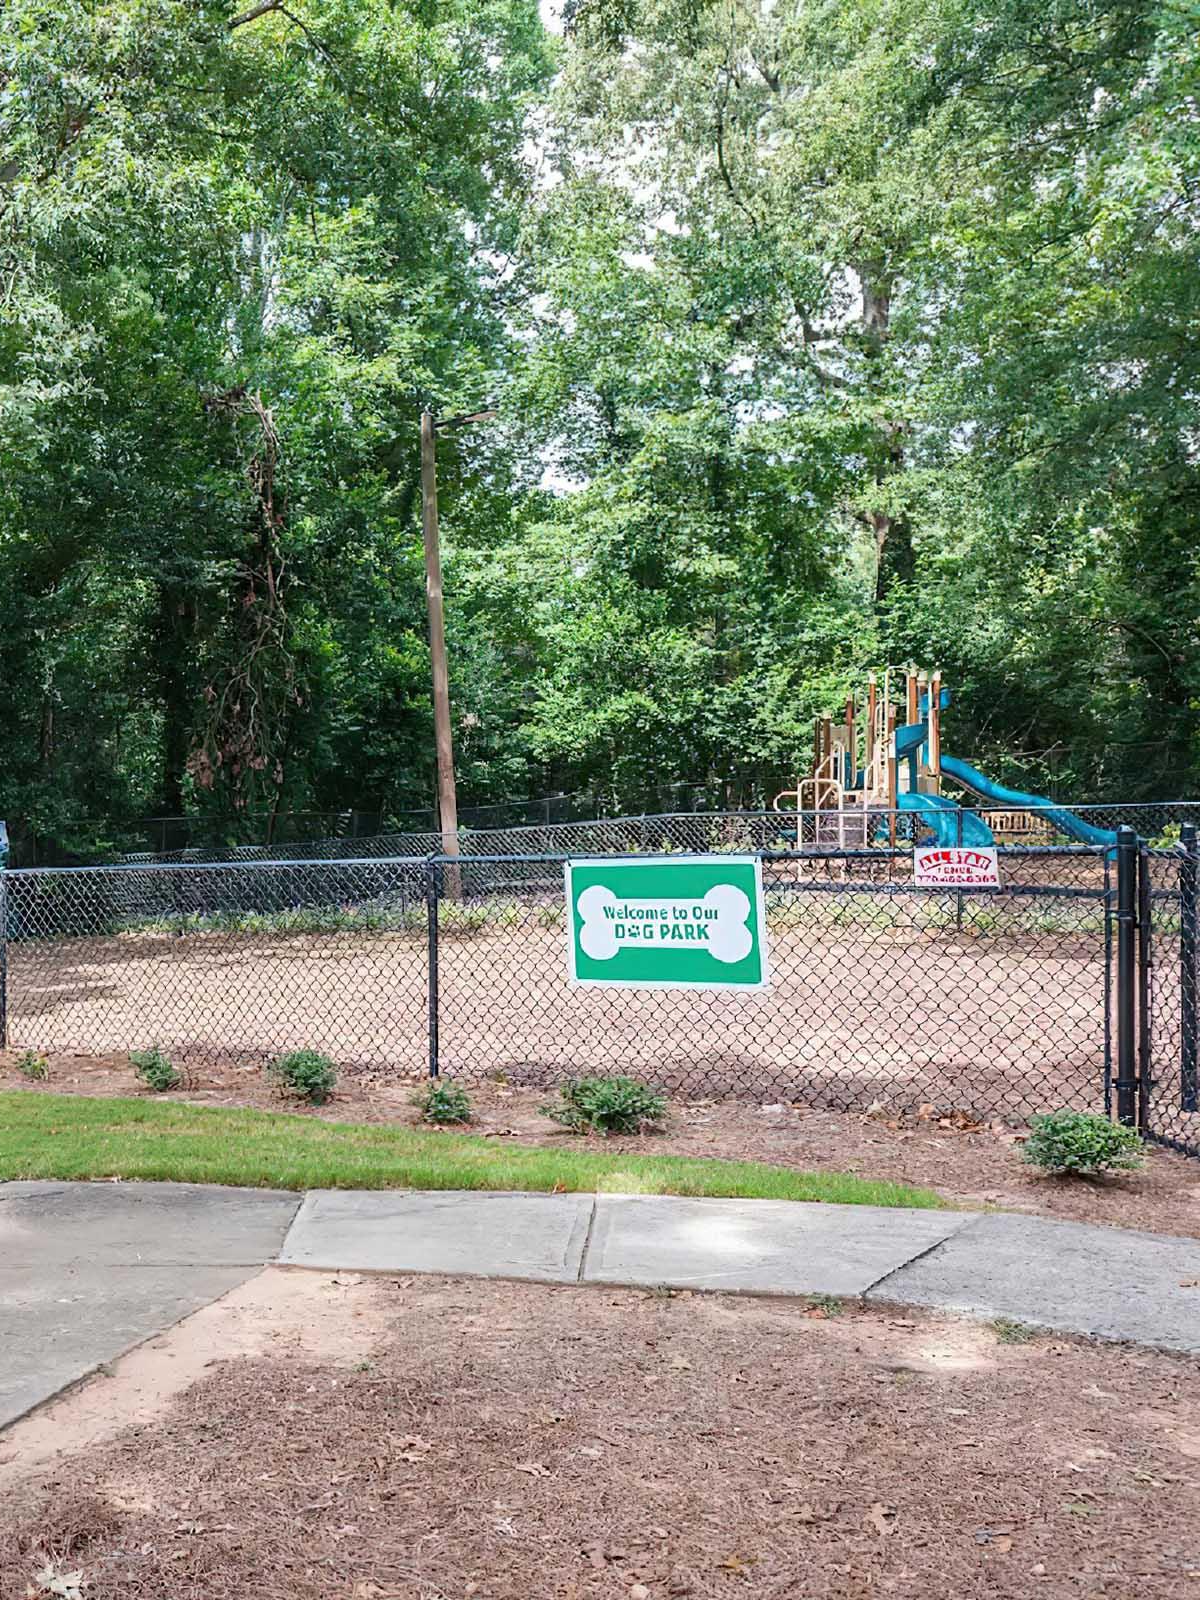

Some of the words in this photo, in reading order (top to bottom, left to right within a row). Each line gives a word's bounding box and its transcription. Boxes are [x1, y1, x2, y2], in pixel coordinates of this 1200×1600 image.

[603, 904, 668, 920] Welcome
[673, 906, 688, 920] to
[692, 906, 718, 920] Our
[660, 924, 710, 940] PARK
